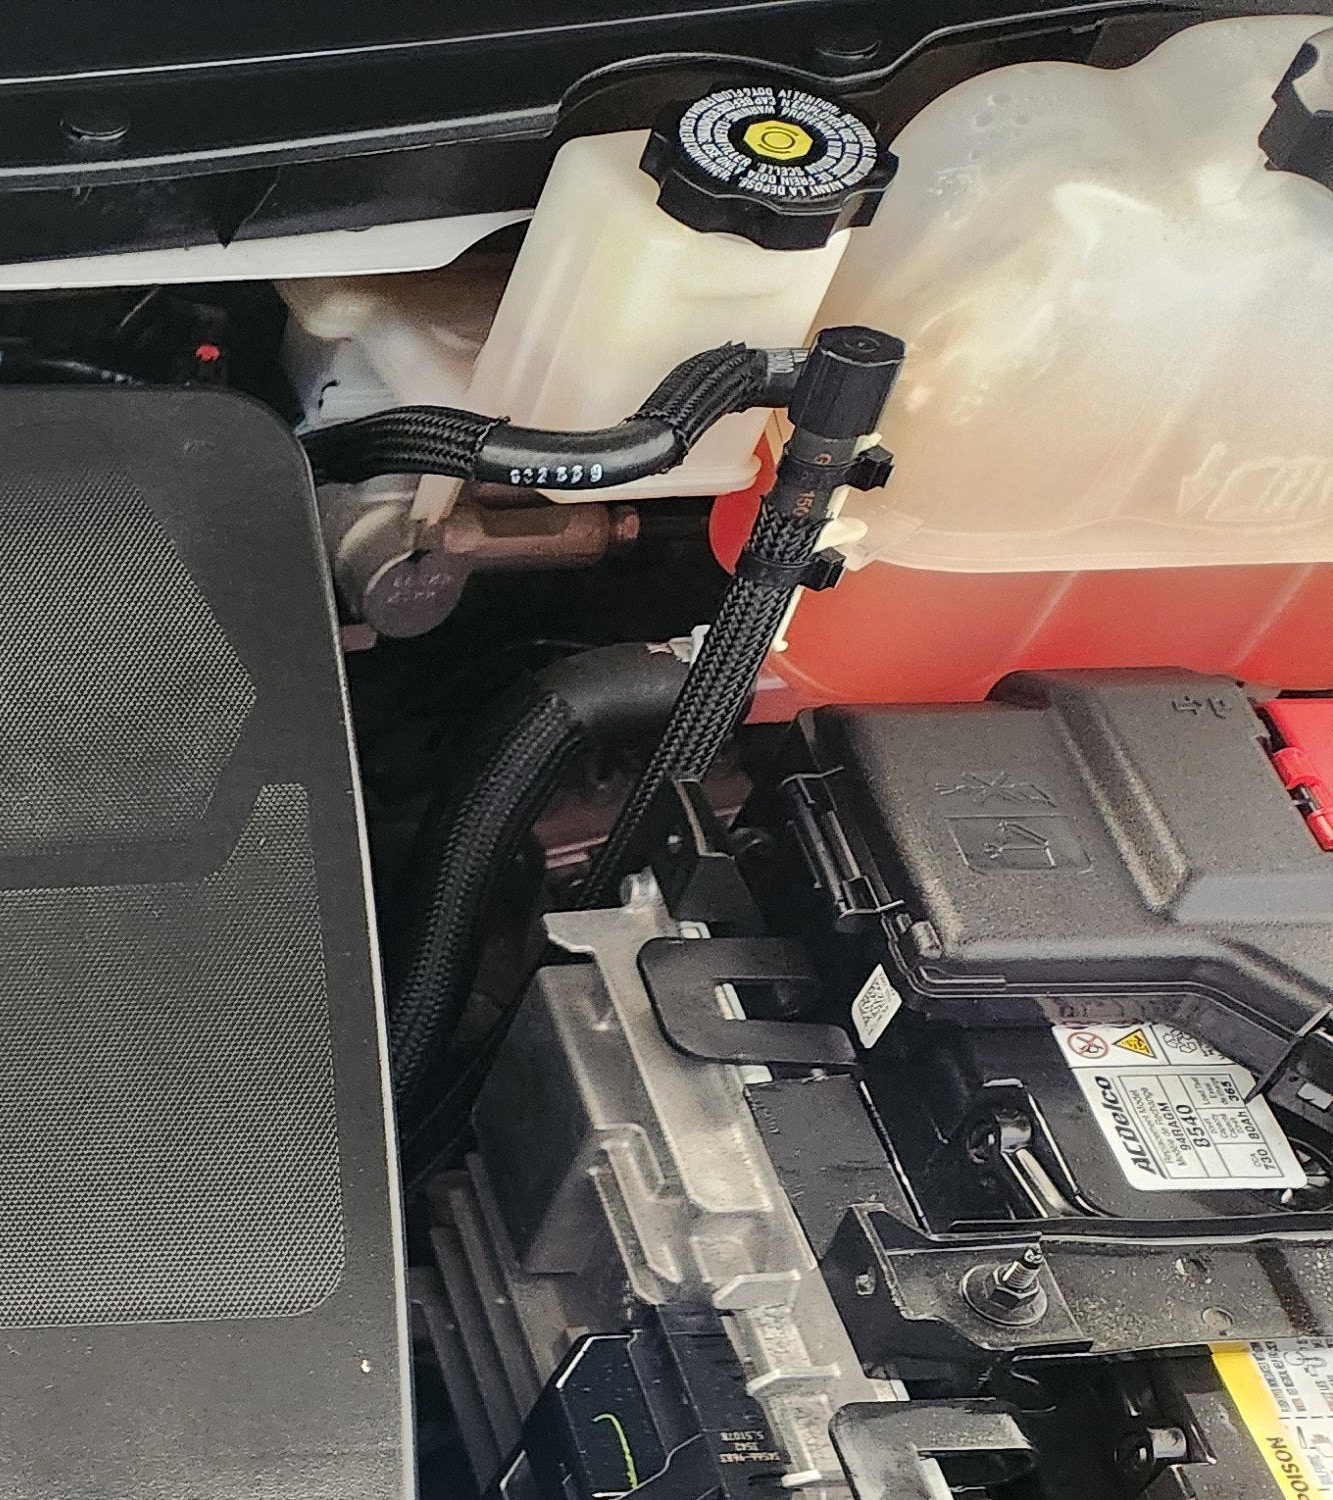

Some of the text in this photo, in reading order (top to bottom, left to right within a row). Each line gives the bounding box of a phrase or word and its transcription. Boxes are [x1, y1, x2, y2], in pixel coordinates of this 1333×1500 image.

[1220, 1080, 1240, 1102] 365
[1094, 1075, 1157, 1175] ACDelco
[1175, 1104, 1211, 1148] 8540
[1237, 1110, 1261, 1140] 80Ah
[1256, 1148, 1276, 1171] 730
